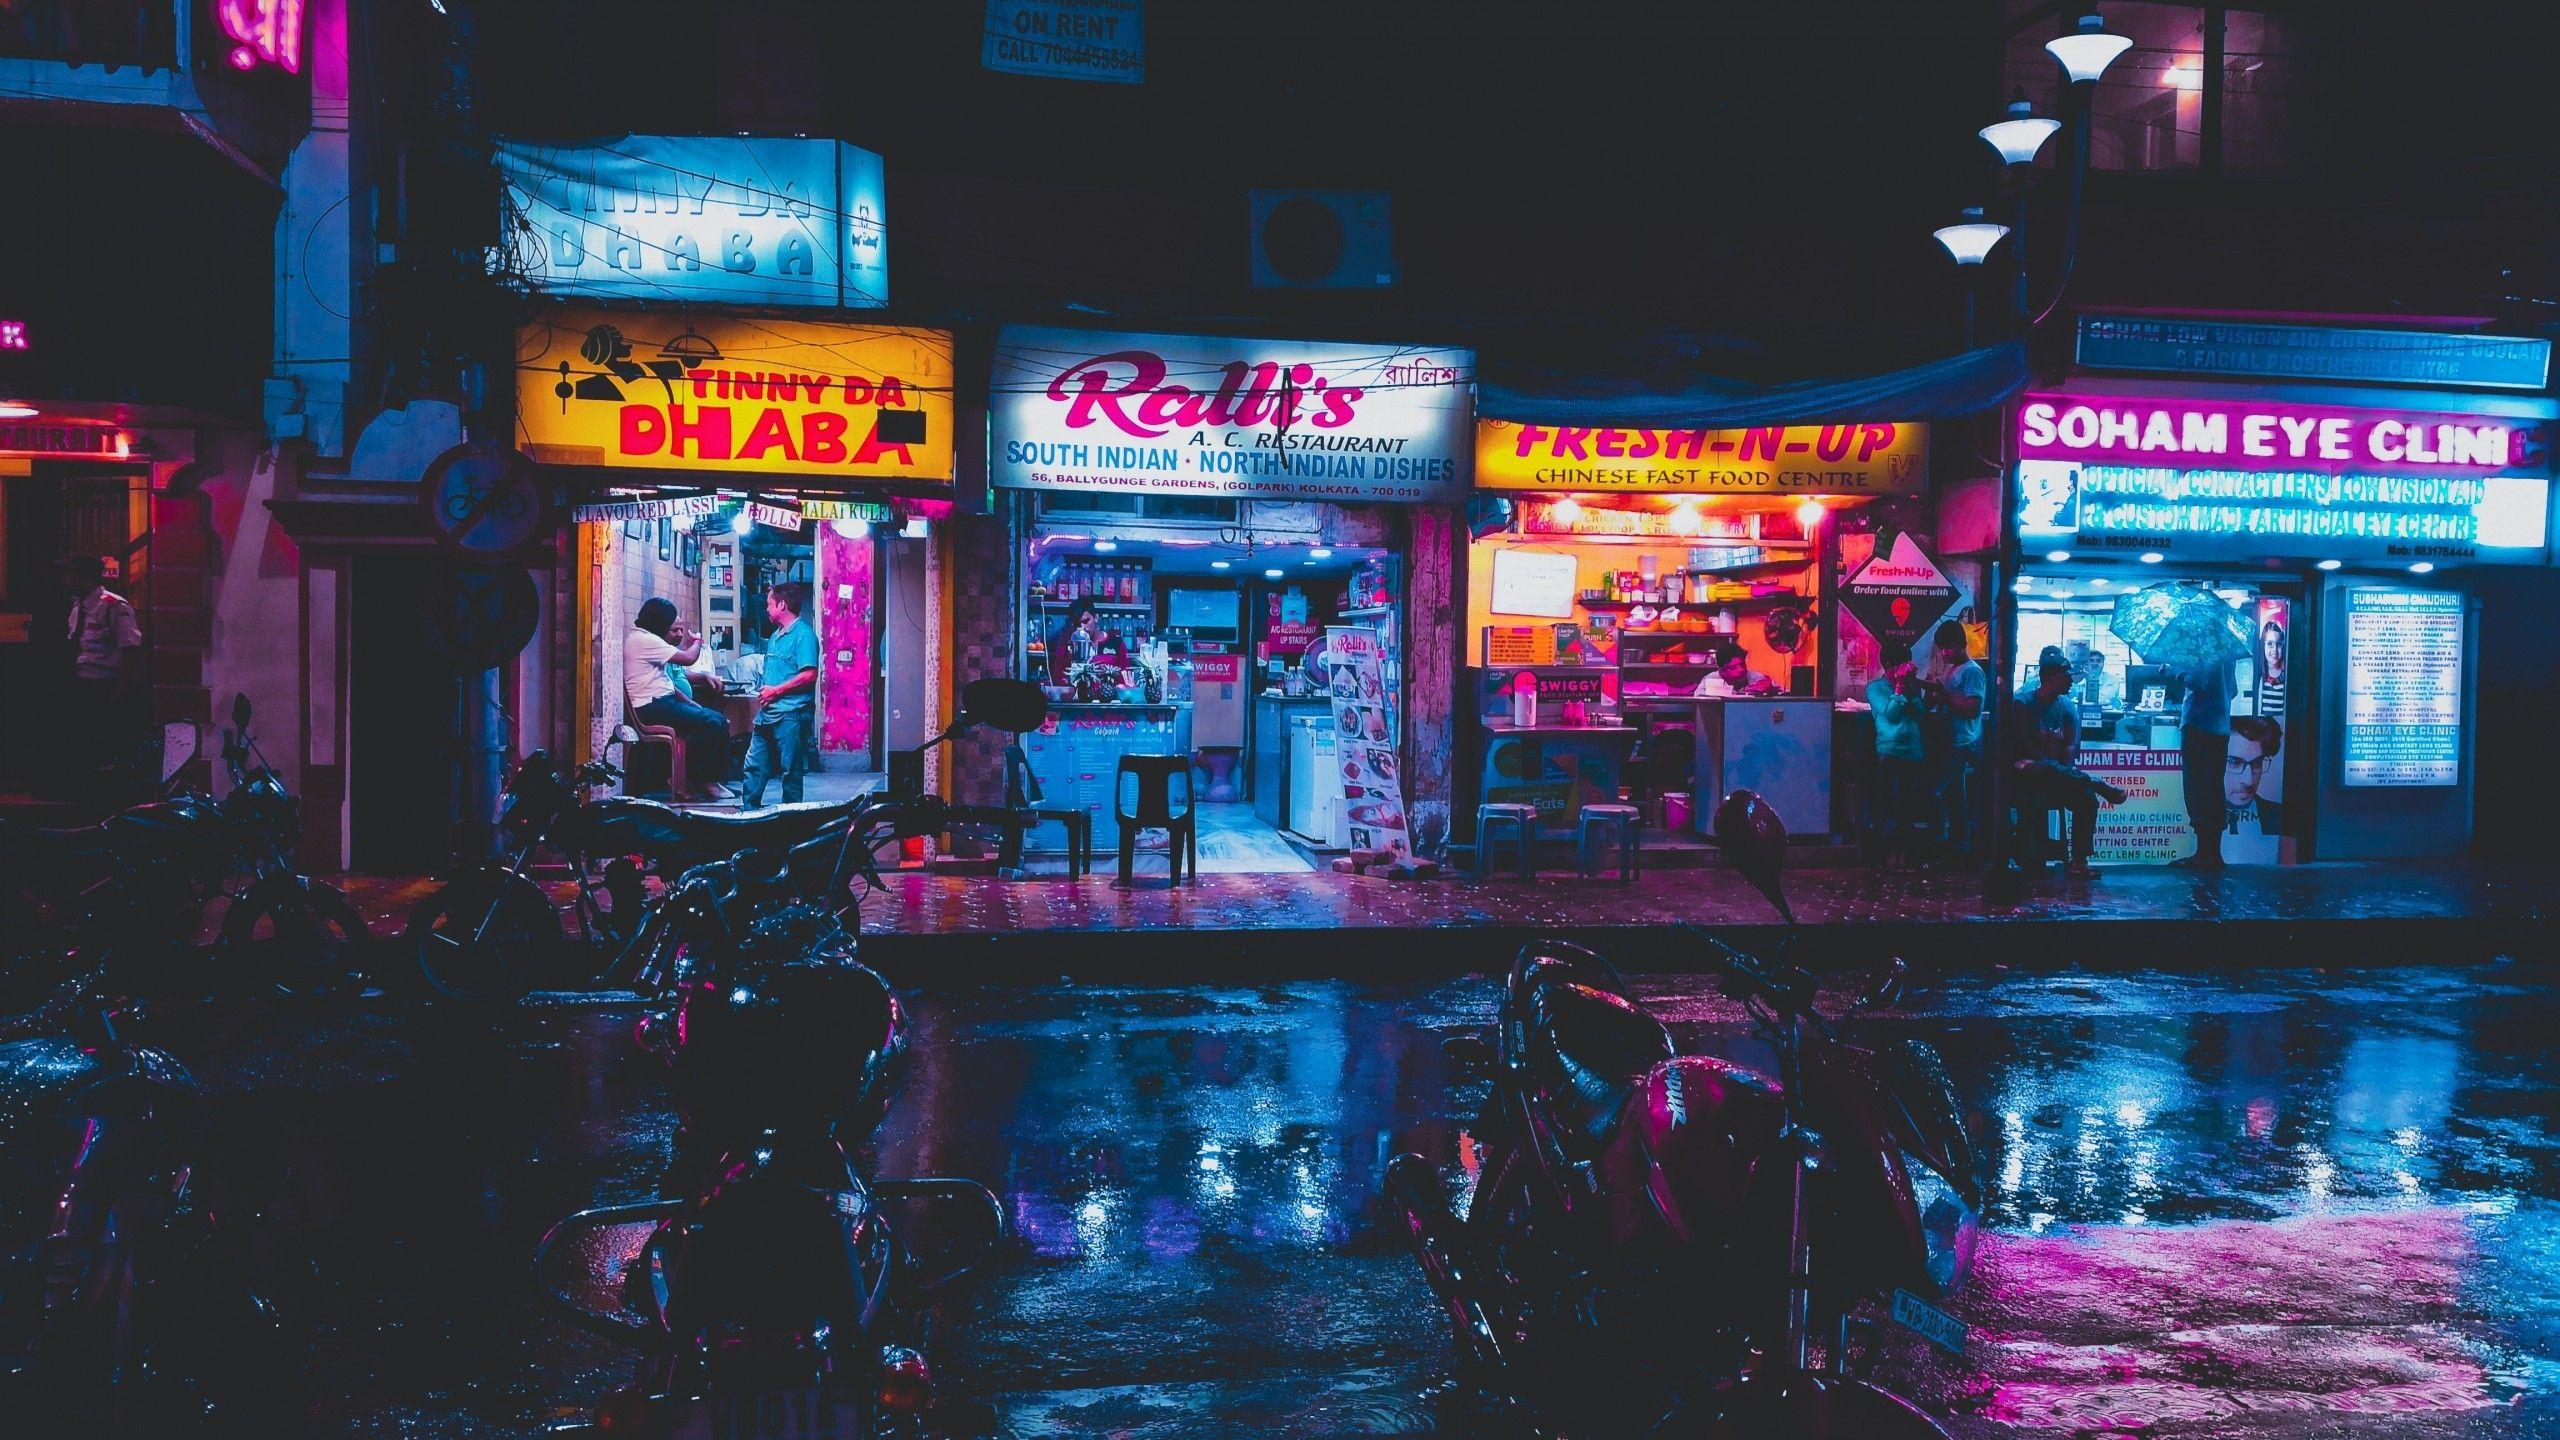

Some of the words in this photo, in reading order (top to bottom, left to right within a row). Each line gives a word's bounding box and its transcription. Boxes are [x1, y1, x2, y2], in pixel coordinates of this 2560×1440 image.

[1014, 10, 1048, 34] ON
[1056, 13, 1119, 40] RENT
[998, 39, 1039, 64] CALL
[549, 221, 814, 276] DHABA
[2214, 328, 2281, 346] VISION
[2193, 350, 2260, 370] FACIAL
[2266, 352, 2385, 377] PROSTHESIS
[687, 369, 831, 406] TINNY
[843, 375, 907, 408] DA
[1046, 349, 1364, 439] Ralli's
[620, 403, 915, 466] DHABA
[2023, 401, 2228, 455] SOHAM
[2241, 413, 2353, 460] EYE
[1188, 431, 1212, 447] A.
[1224, 432, 1243, 448] C.
[1255, 433, 1408, 455] RESTAURANT
[1007, 440, 1088, 468] SOUTH
[1097, 446, 1178, 471] INDIAN
[1200, 450, 1280, 477] NORTH
[1287, 453, 1366, 479] INDIAN
[1374, 456, 1455, 482] DISHES
[1031, 473, 1051, 484] 56,
[1056, 474, 1147, 486] BALLYGUNGE
[1151, 478, 1220, 491] GARDENS,
[1223, 481, 1295, 494] (GOLPARK)
[1299, 484, 1360, 496] KOLKATA
[1371, 487, 1394, 496] 700
[1536, 467, 1638, 484] CHINESE
[1647, 468, 1701, 485] FAST
[1708, 470, 1770, 486] FOOD
[1777, 471, 1868, 487] CENTRE
[576, 502, 668, 521] FLAVOURED
[672, 497, 717, 516] LASSI
[1869, 566, 1934, 580] Fresh-N-Up
[1853, 585, 1879, 595] Order
[1880, 586, 1900, 595] food
[1901, 587, 1927, 596] online
[1929, 587, 1948, 596] with
[1338, 634, 1366, 652] Ralli's
[1194, 663, 1231, 672] WIGGY
[1540, 680, 1599, 692] SWIGGY
[2351, 726, 2391, 736] SOHAM
[2395, 726, 2416, 736] EYE
[2419, 726, 2456, 736] CLINIC
[2117, 753, 2142, 766] EYE
[2098, 813, 2126, 822] ISION
[2129, 813, 2146, 822] AID
[2149, 813, 2182, 822] CLINIC
[2108, 826, 2134, 835] MADE
[2137, 826, 2187, 835] ARTIFICIAL
[2094, 838, 2128, 847] ITTING
[2131, 838, 2170, 847] CENTRE
[2116, 850, 2141, 859] LENS
[2144, 850, 2177, 859] CLINIC
